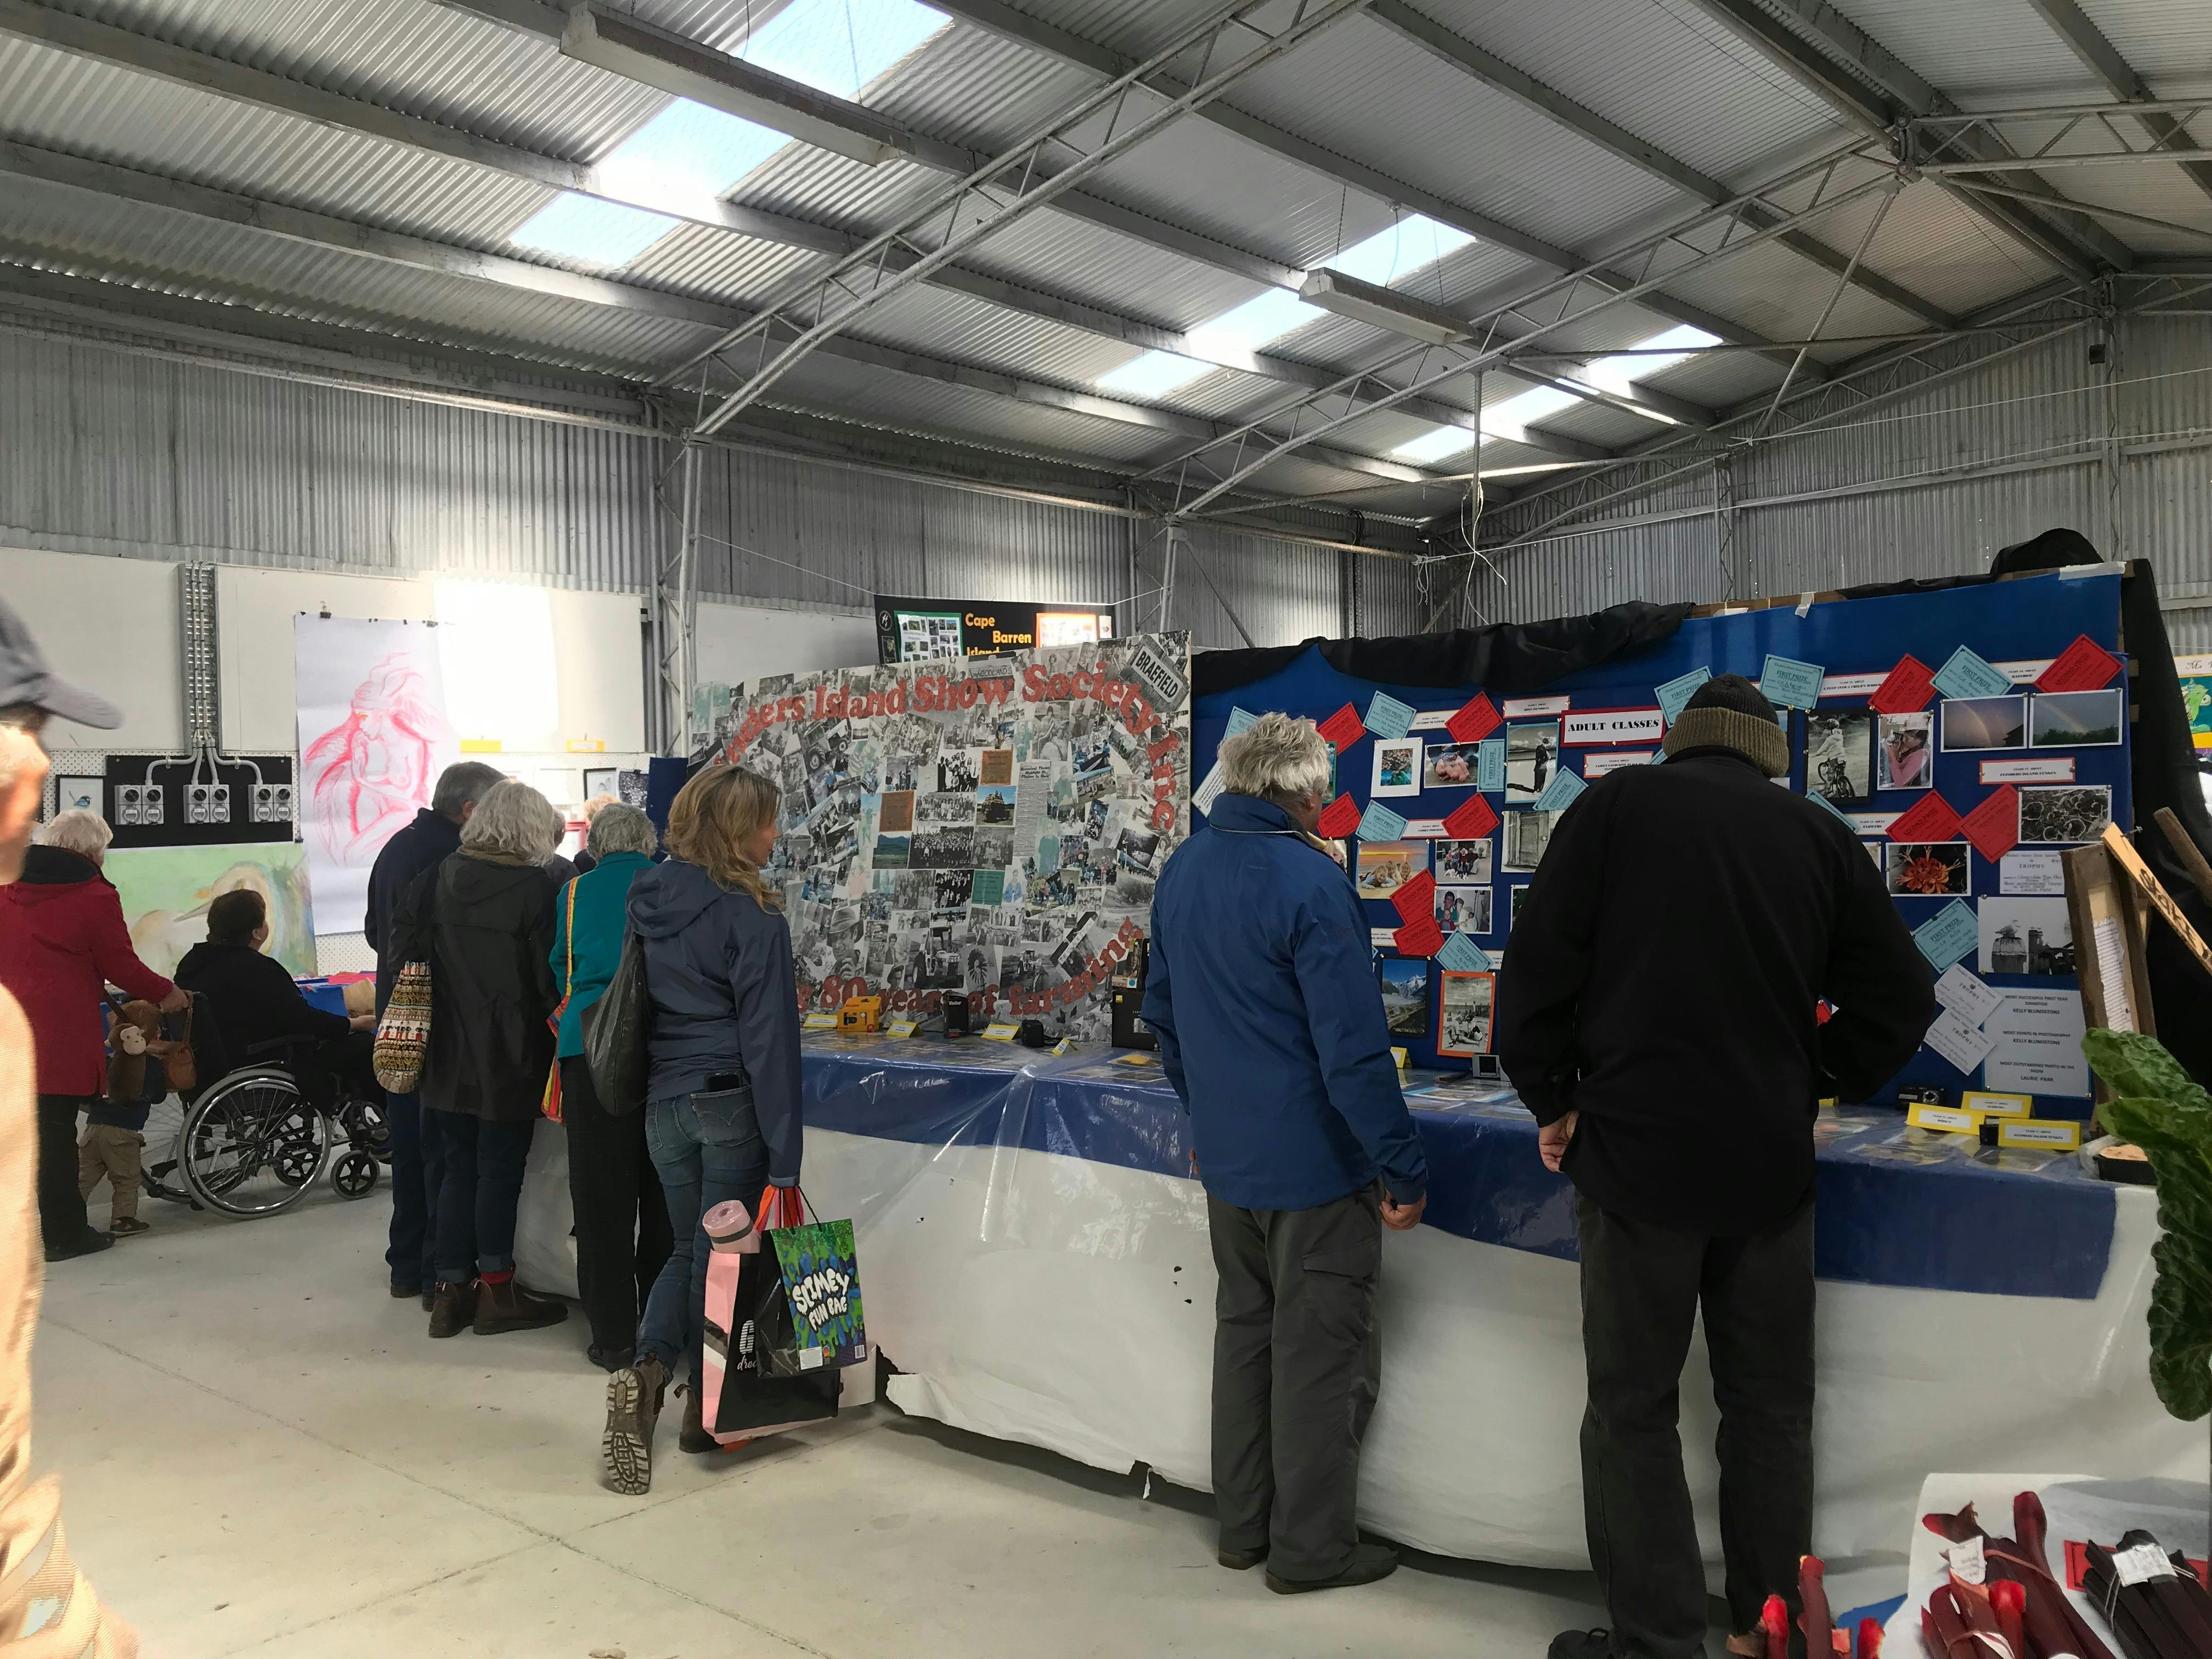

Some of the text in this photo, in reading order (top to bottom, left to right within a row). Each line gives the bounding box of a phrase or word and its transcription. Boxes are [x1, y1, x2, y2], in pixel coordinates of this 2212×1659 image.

[965, 613, 995, 627] Cape
[992, 630, 1032, 644] Barren
[1135, 651, 1180, 699] BRAEFIELD
[1962, 665, 1992, 689] FIRST PRIZE
[1671, 682, 1701, 699] FIRST PRIZE
[1380, 706, 1392, 714] FIRST
[1567, 719, 1660, 732] ADULT CLASSES
[813, 678, 907, 720] Island
[913, 674, 1015, 713] Show
[1023, 661, 1161, 735] Society
[1147, 730, 1179, 830] Inc
[1549, 782, 1568, 807] FIRST PRIZE
[1374, 815, 1395, 829] FIRST PRIZE
[1929, 917, 1961, 942] FIRST PRIZE
[820, 974, 867, 1008] 80
[878, 988, 943, 1015] year
[967, 984, 999, 1014] of
[1008, 916, 1144, 1016] farming
[1457, 944, 1468, 956] FIRST
[1467, 954, 1479, 967] PRIZE
[1959, 982, 1979, 1000] TROPHY
[1952, 1028, 1973, 1045] TROPHY
[792, 1268, 850, 1315] SLIMEY
[809, 1296, 847, 1331] FUN BAG
